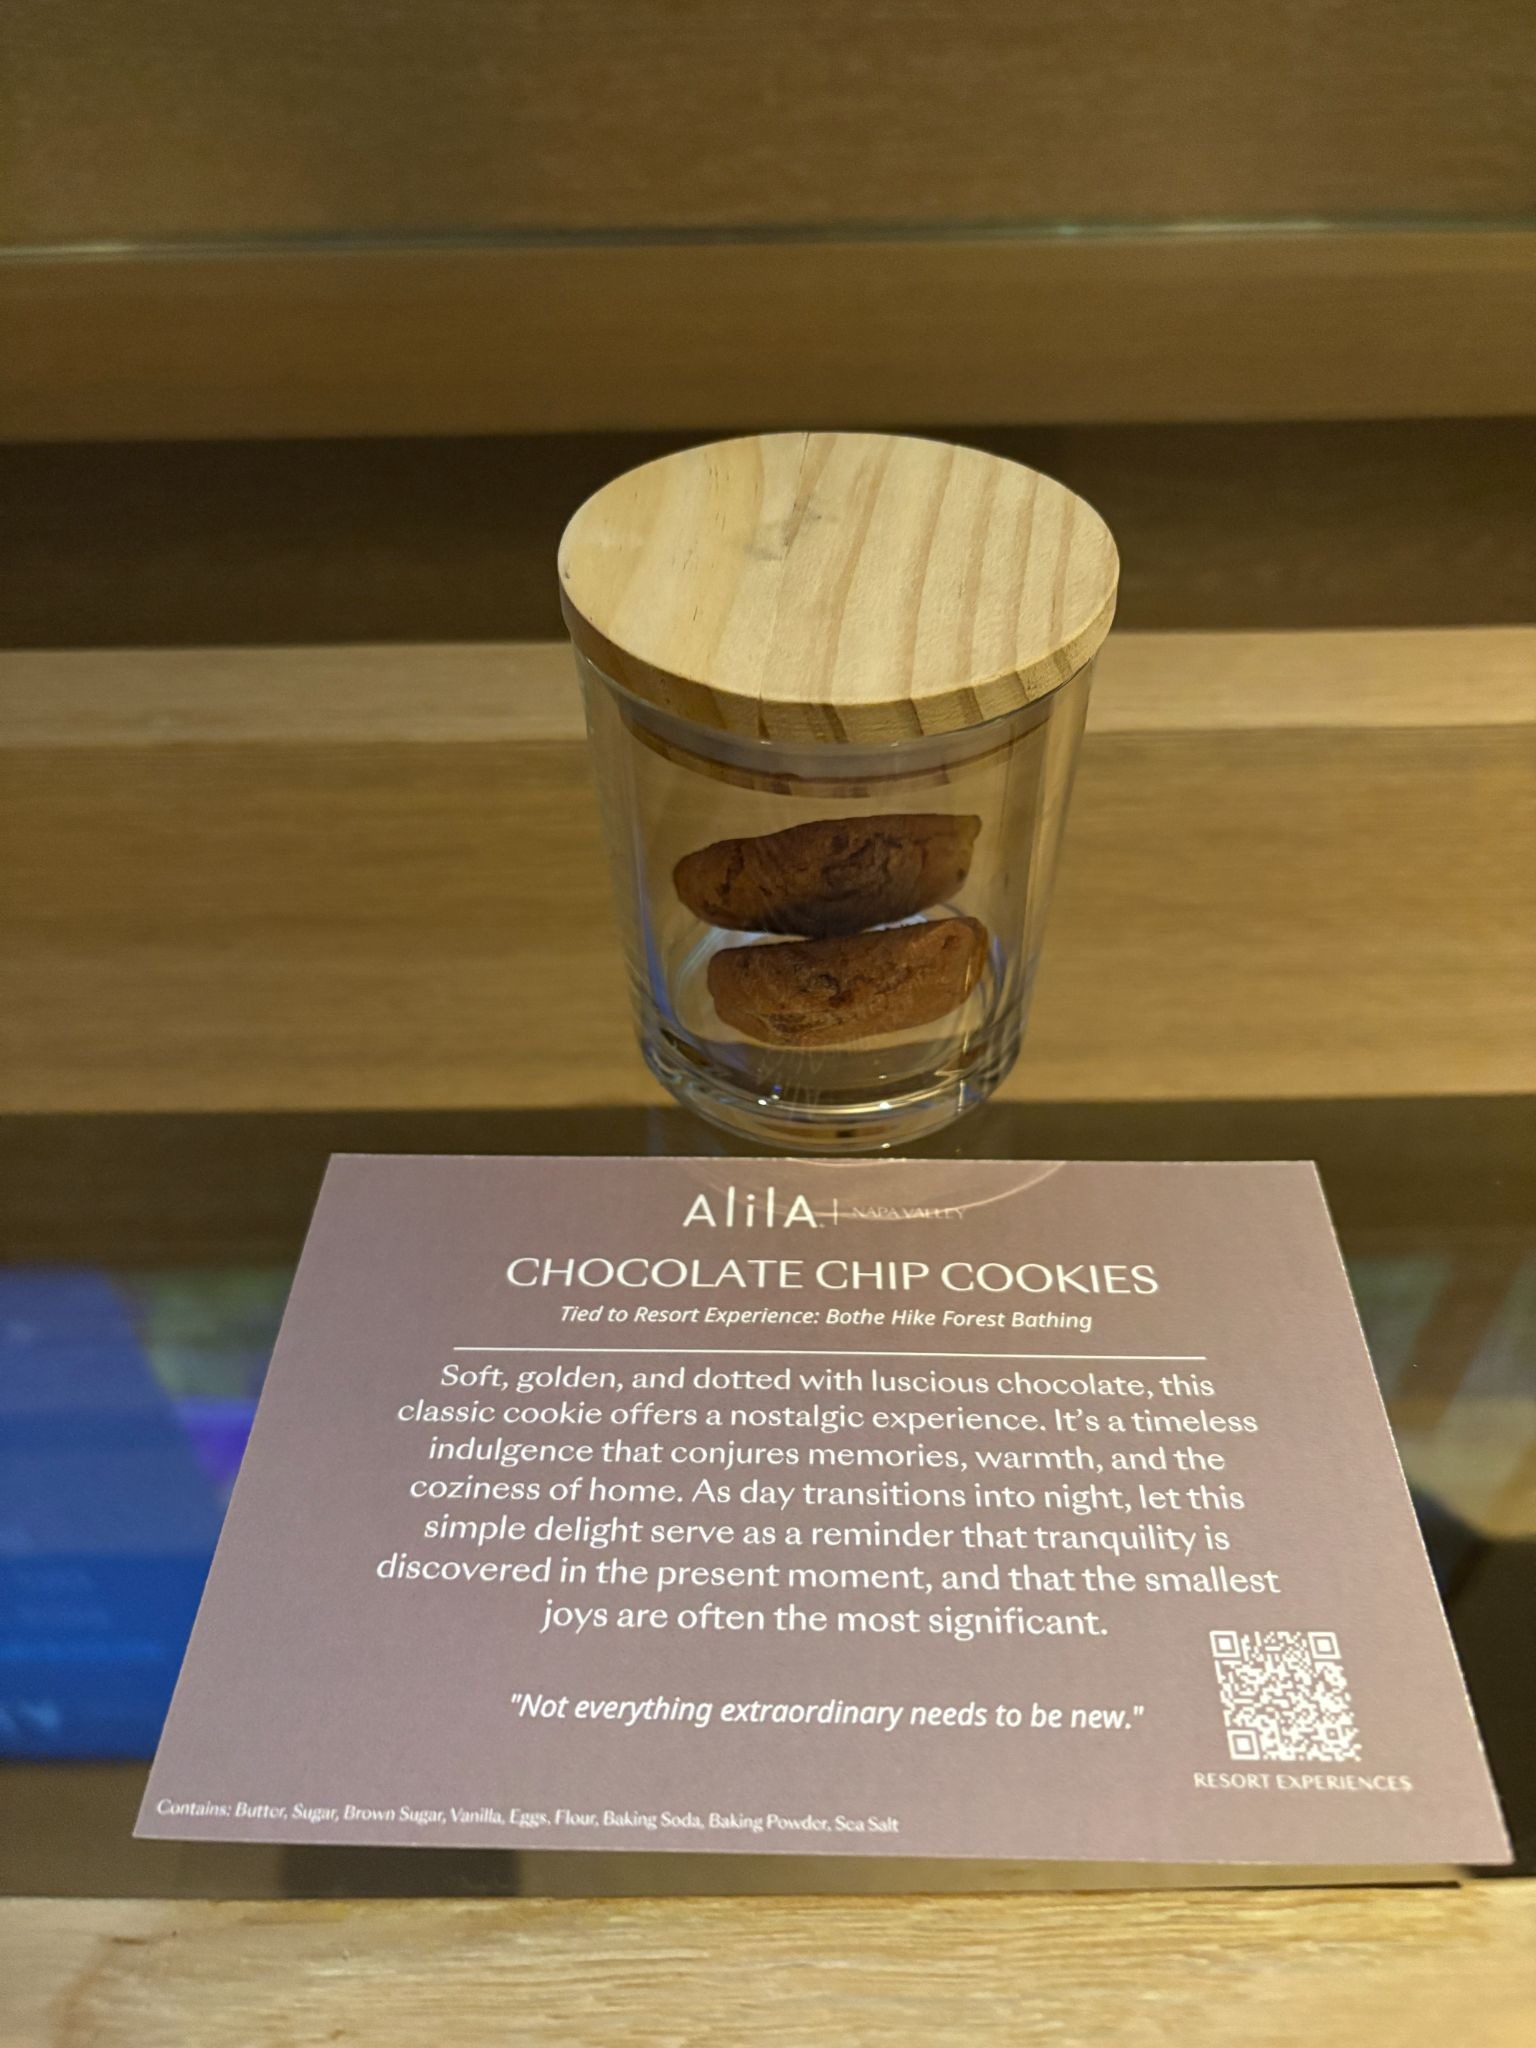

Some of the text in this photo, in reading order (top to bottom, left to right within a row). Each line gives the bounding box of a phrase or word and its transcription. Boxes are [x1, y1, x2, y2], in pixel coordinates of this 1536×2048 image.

[852, 1205, 900, 1220] NAPA
[902, 1206, 966, 1221] VALLEY
[506, 1257, 1159, 1295] CHOCOLATE CHIP COOKIES
[561, 1305, 1093, 1334] Tied to Resort Experience: Bothe Hike Forest Bathing
[440, 1363, 1215, 1400] Soft, golden, and dotted with luscious chocolate, this
[397, 1398, 1259, 1436] classic cookie offers a nostalgic experience. It’s a timeless
[428, 1435, 1225, 1474] indulgence that conjures memories, warmth, and the
[409, 1474, 1245, 1516] coziness of home. As day transitions into night, let this
[423, 1513, 1231, 1557] simple delight serve as a reminder that tranquility is
[376, 1552, 1281, 1595] discovered in the present moment, and that the smallest
[539, 1598, 1108, 1642] joys are often the most significant.
[510, 1693, 1145, 1732] "Not everything extraordinary needs to be new."
[1193, 1772, 1414, 1793] RESORT EXPERIENCES
[155, 1798, 899, 1834] Contains: Butter, Sugar, Brown Sugar, Vanilla, Eggs, Flour, Baking Soda, Baking Powder, Sea Salt
